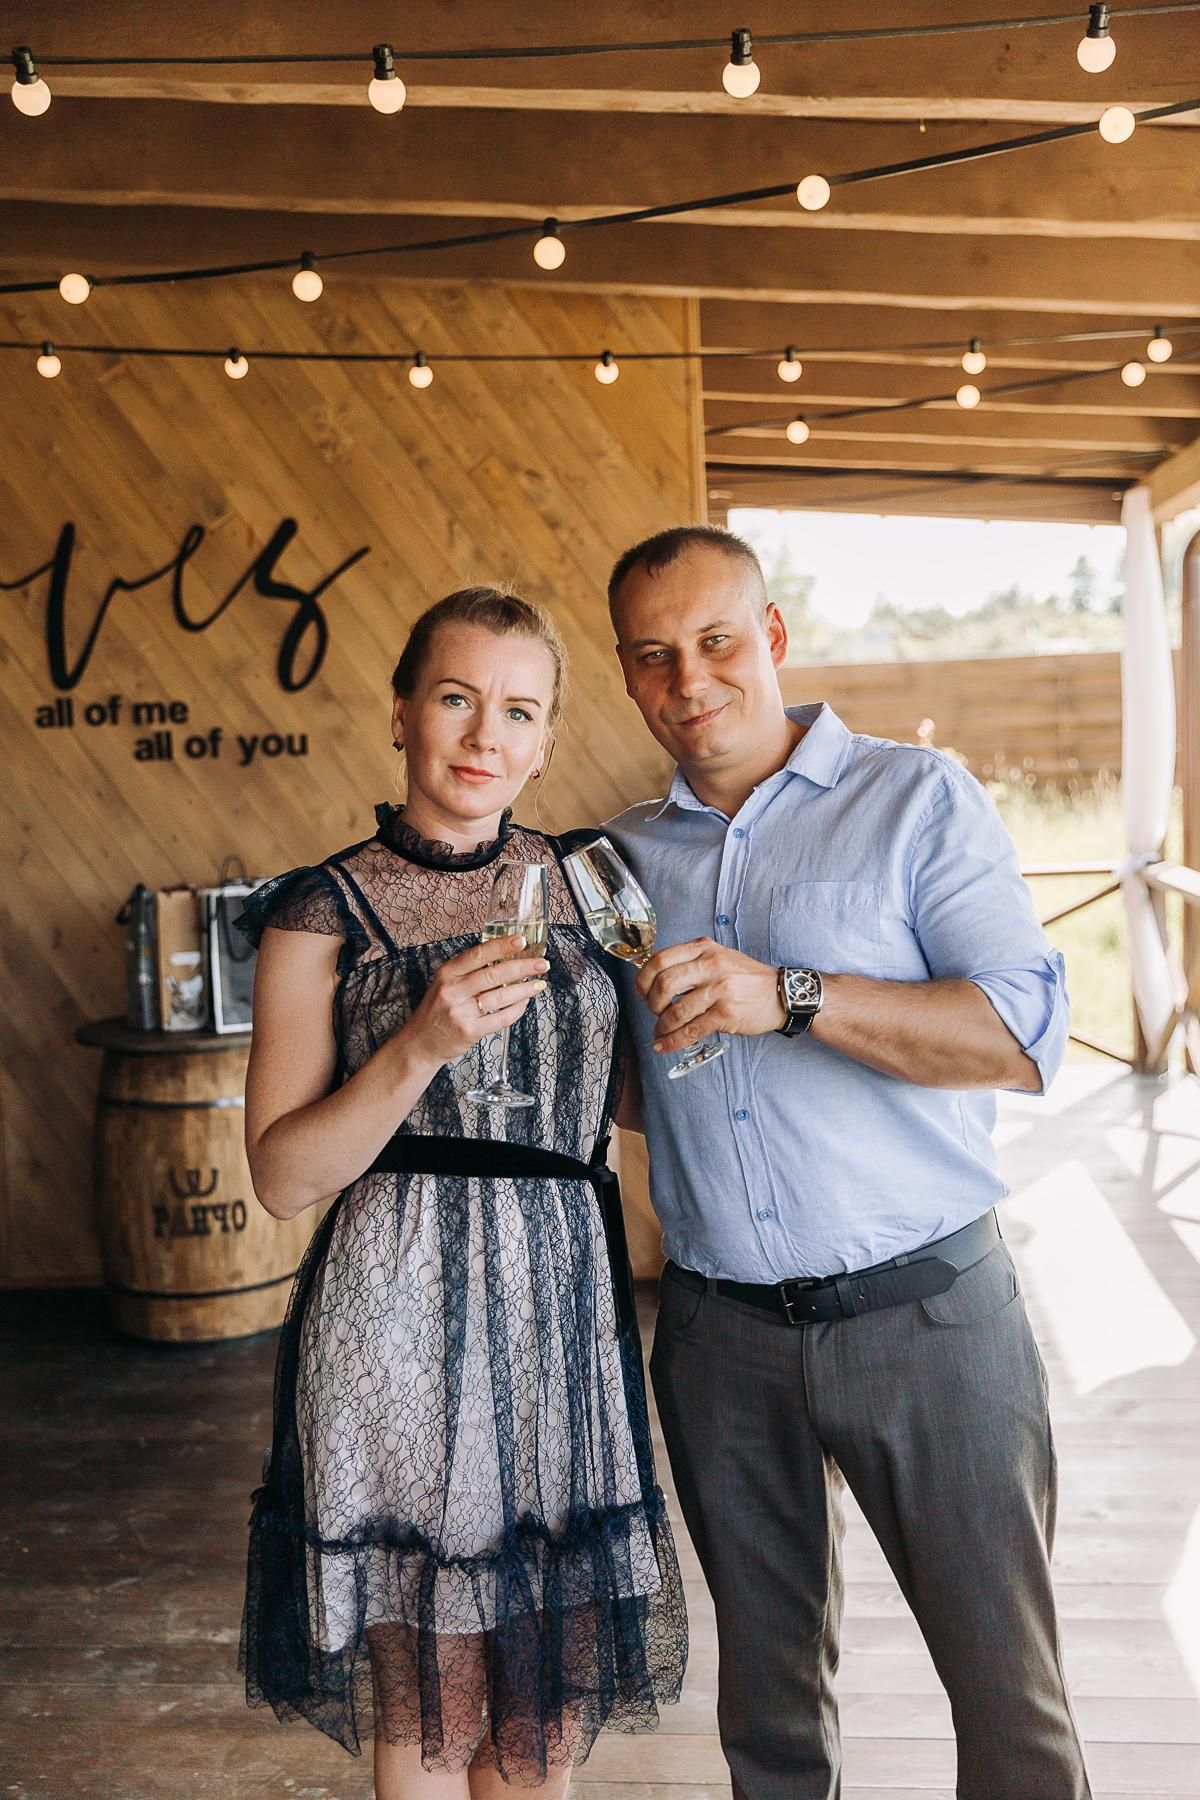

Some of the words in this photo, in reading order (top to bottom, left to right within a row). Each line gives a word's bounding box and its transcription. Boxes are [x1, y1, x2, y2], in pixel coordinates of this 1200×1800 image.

[0, 517, 372, 693] ves
[35, 698, 74, 728] all
[84, 694, 122, 726] of
[132, 700, 190, 726] me
[133, 731, 174, 761] all
[184, 727, 223, 759] of
[236, 733, 310, 766] you
